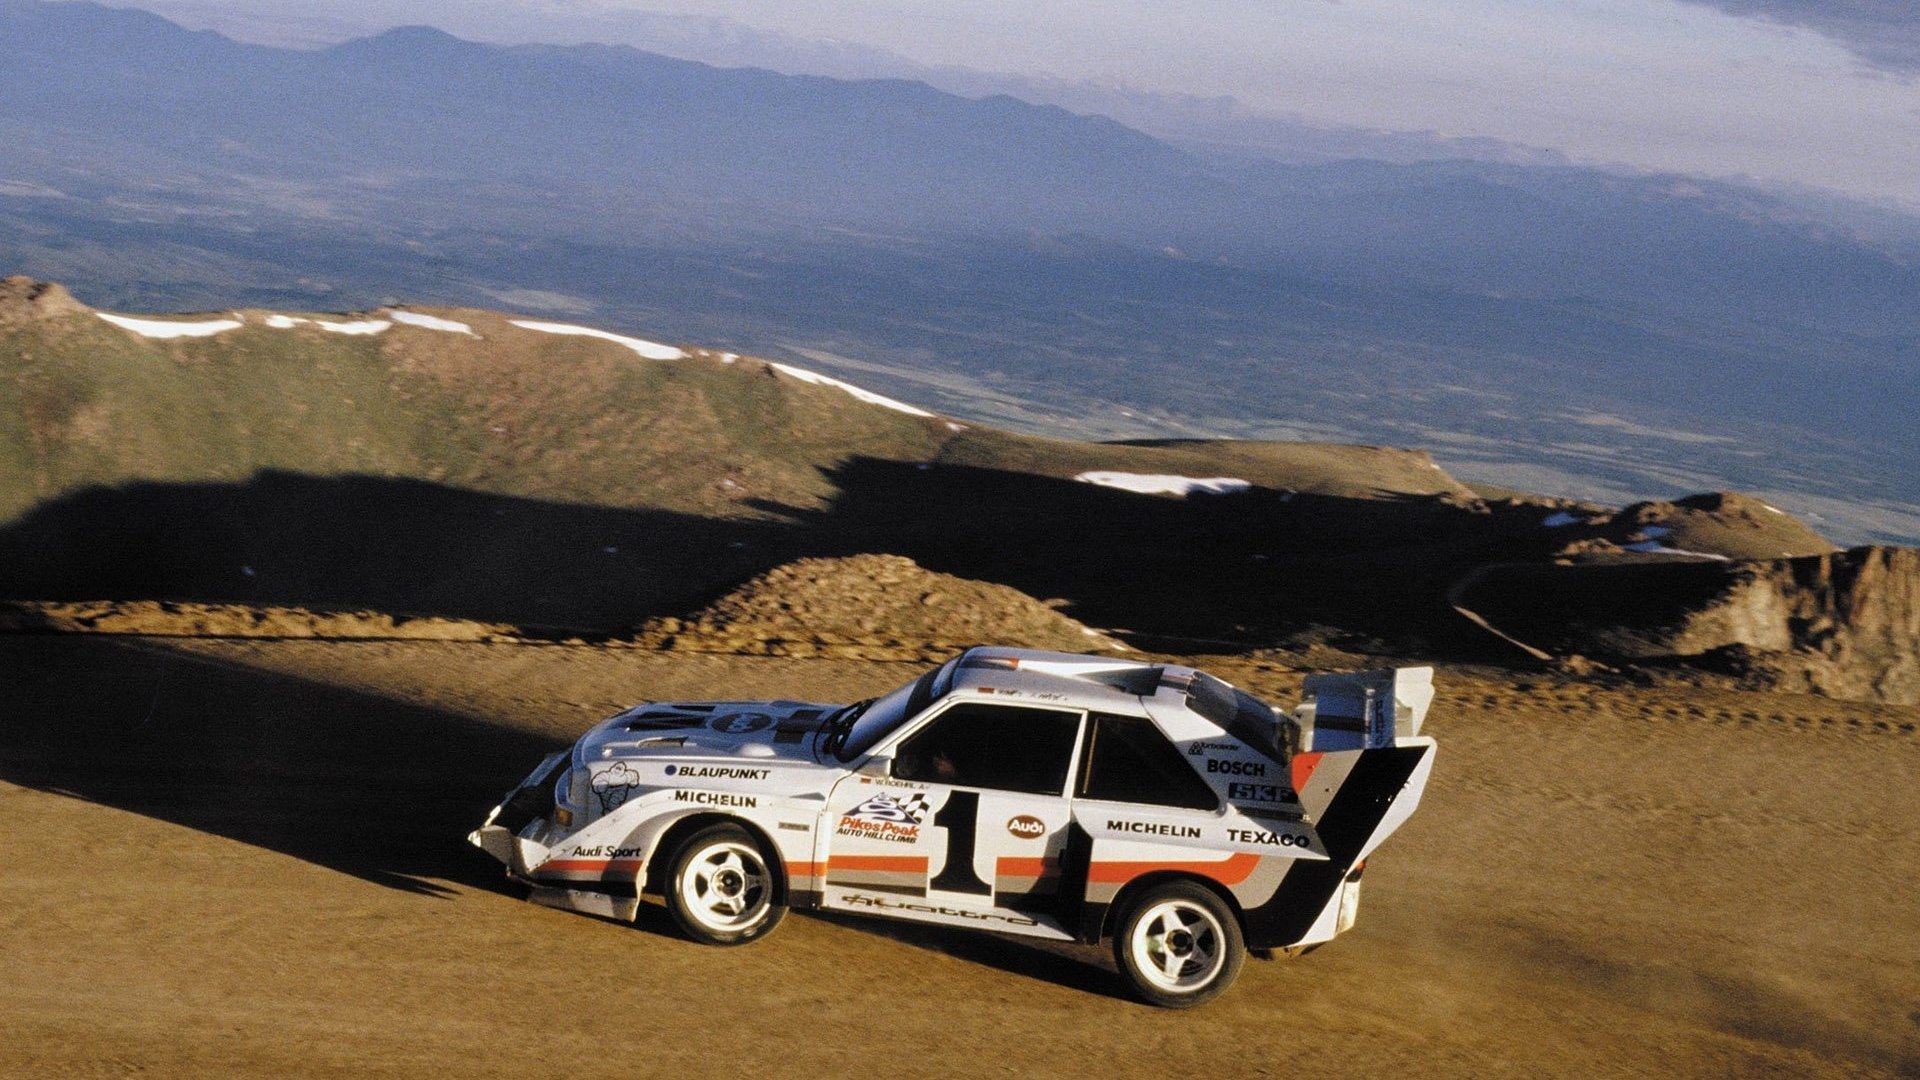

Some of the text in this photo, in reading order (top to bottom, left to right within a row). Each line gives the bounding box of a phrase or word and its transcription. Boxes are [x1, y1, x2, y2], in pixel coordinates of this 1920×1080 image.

[678, 766, 771, 780] BLAUPUNKT
[1207, 759, 1265, 776] BOSCH
[675, 790, 757, 808] MICHELIN
[1234, 784, 1291, 803] SKF
[836, 828, 863, 838] AUTO
[840, 816, 920, 836] Pikes Peak
[1008, 818, 1043, 834] Audi
[1106, 820, 1201, 838] MICHELIN
[930, 790, 992, 896] 1
[1227, 828, 1310, 848] TEXACO
[572, 845, 642, 859] Audi Sport
[841, 894, 1039, 926] quattro
